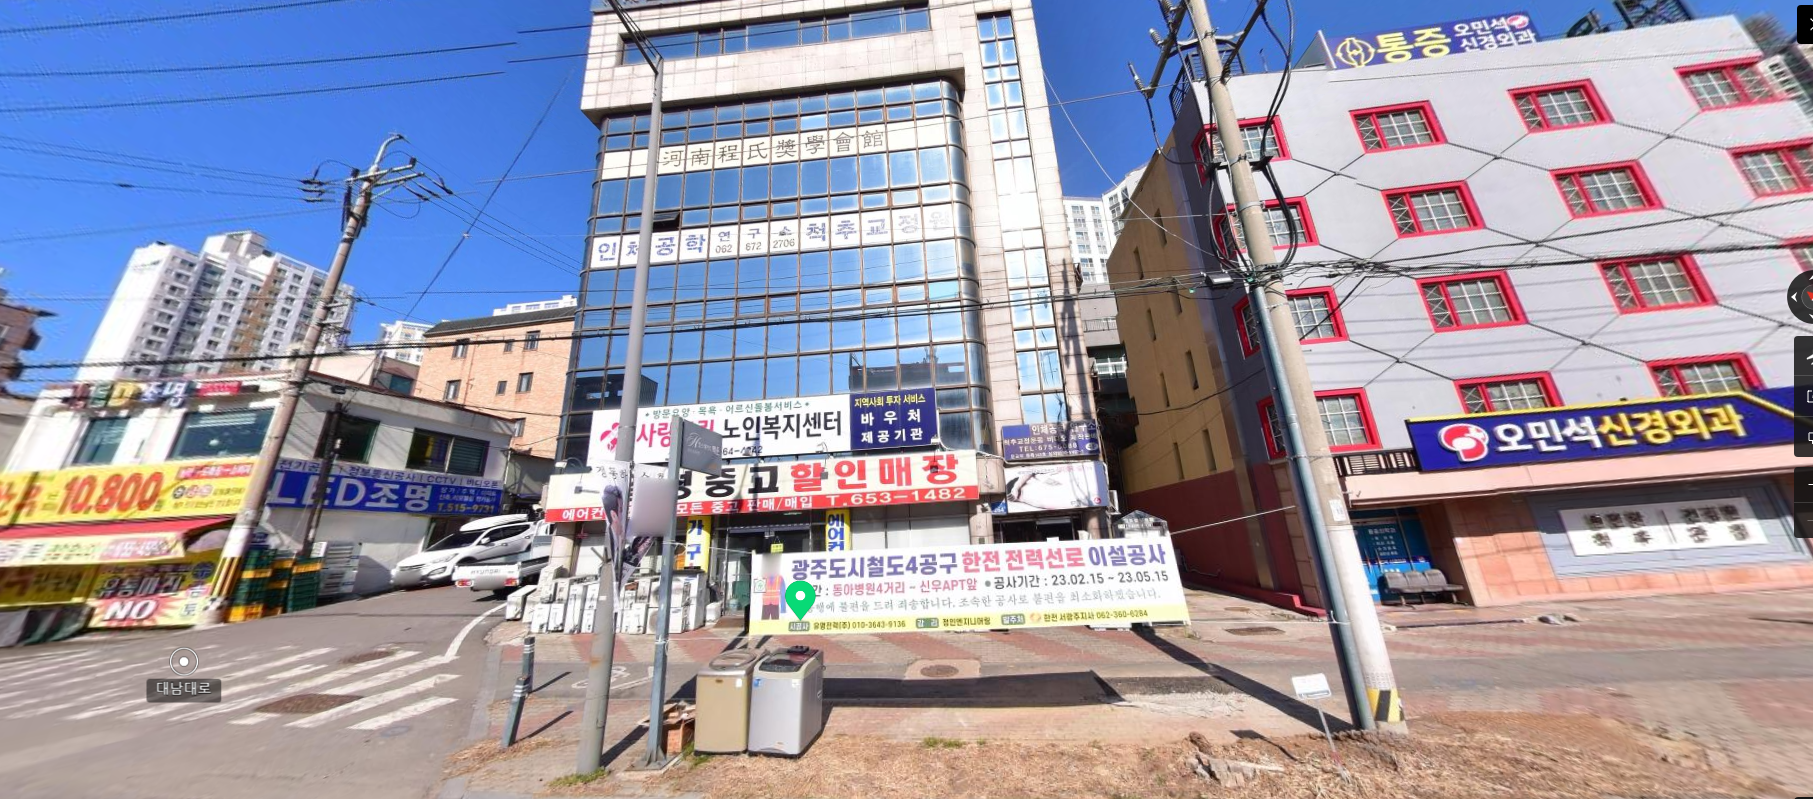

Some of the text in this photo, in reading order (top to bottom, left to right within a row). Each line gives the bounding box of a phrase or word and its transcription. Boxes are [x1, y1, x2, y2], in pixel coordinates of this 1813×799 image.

[1453, 15, 1509, 38] 오민석
[1376, 27, 1451, 63] 통증
[1460, 29, 1537, 52] 신경외과
[715, 238, 796, 254] 062 672 2706
[653, 400, 803, 420] 방문요양 목욕 어르신돌봄서비스
[854, 393, 926, 408] 지역사회 투자 서비스
[723, 411, 842, 442] 노인복지센터
[861, 408, 922, 426] 바우처
[861, 428, 924, 444] 제공기관
[349, 465, 418, 482] 정보통신공사
[426, 475, 456, 485] CCTV
[790, 453, 960, 493] 할인매장
[267, 472, 432, 513] LED조명
[677, 501, 703, 516] 모든
[711, 497, 740, 514] 중고
[747, 495, 813, 511] 판매/매입
[826, 486, 967, 508] T.653-1482
[686, 519, 704, 561] 가구
[791, 543, 1167, 580] 광주도시철도4공구 한전 전력선로 이설공사
[832, 582, 906, 597] 동아병원4거리
[919, 578, 978, 593] 신우APT앞
[993, 575, 1041, 590] 공사기간
[1051, 572, 1105, 586] 23.02.15
[1118, 570, 1169, 583] 23.05.15
[103, 600, 158, 621] NO
[838, 600, 869, 613] 불편을
[898, 596, 955, 610] 죄송합니다.
[958, 592, 992, 607] 조속한
[994, 591, 1030, 605] 공사로
[1033, 591, 1066, 604] 불편을
[1070, 587, 1161, 602] 최소화하겠습니다.
[852, 618, 906, 628] 010-3643-9136
[1044, 613, 1058, 622] 한전
